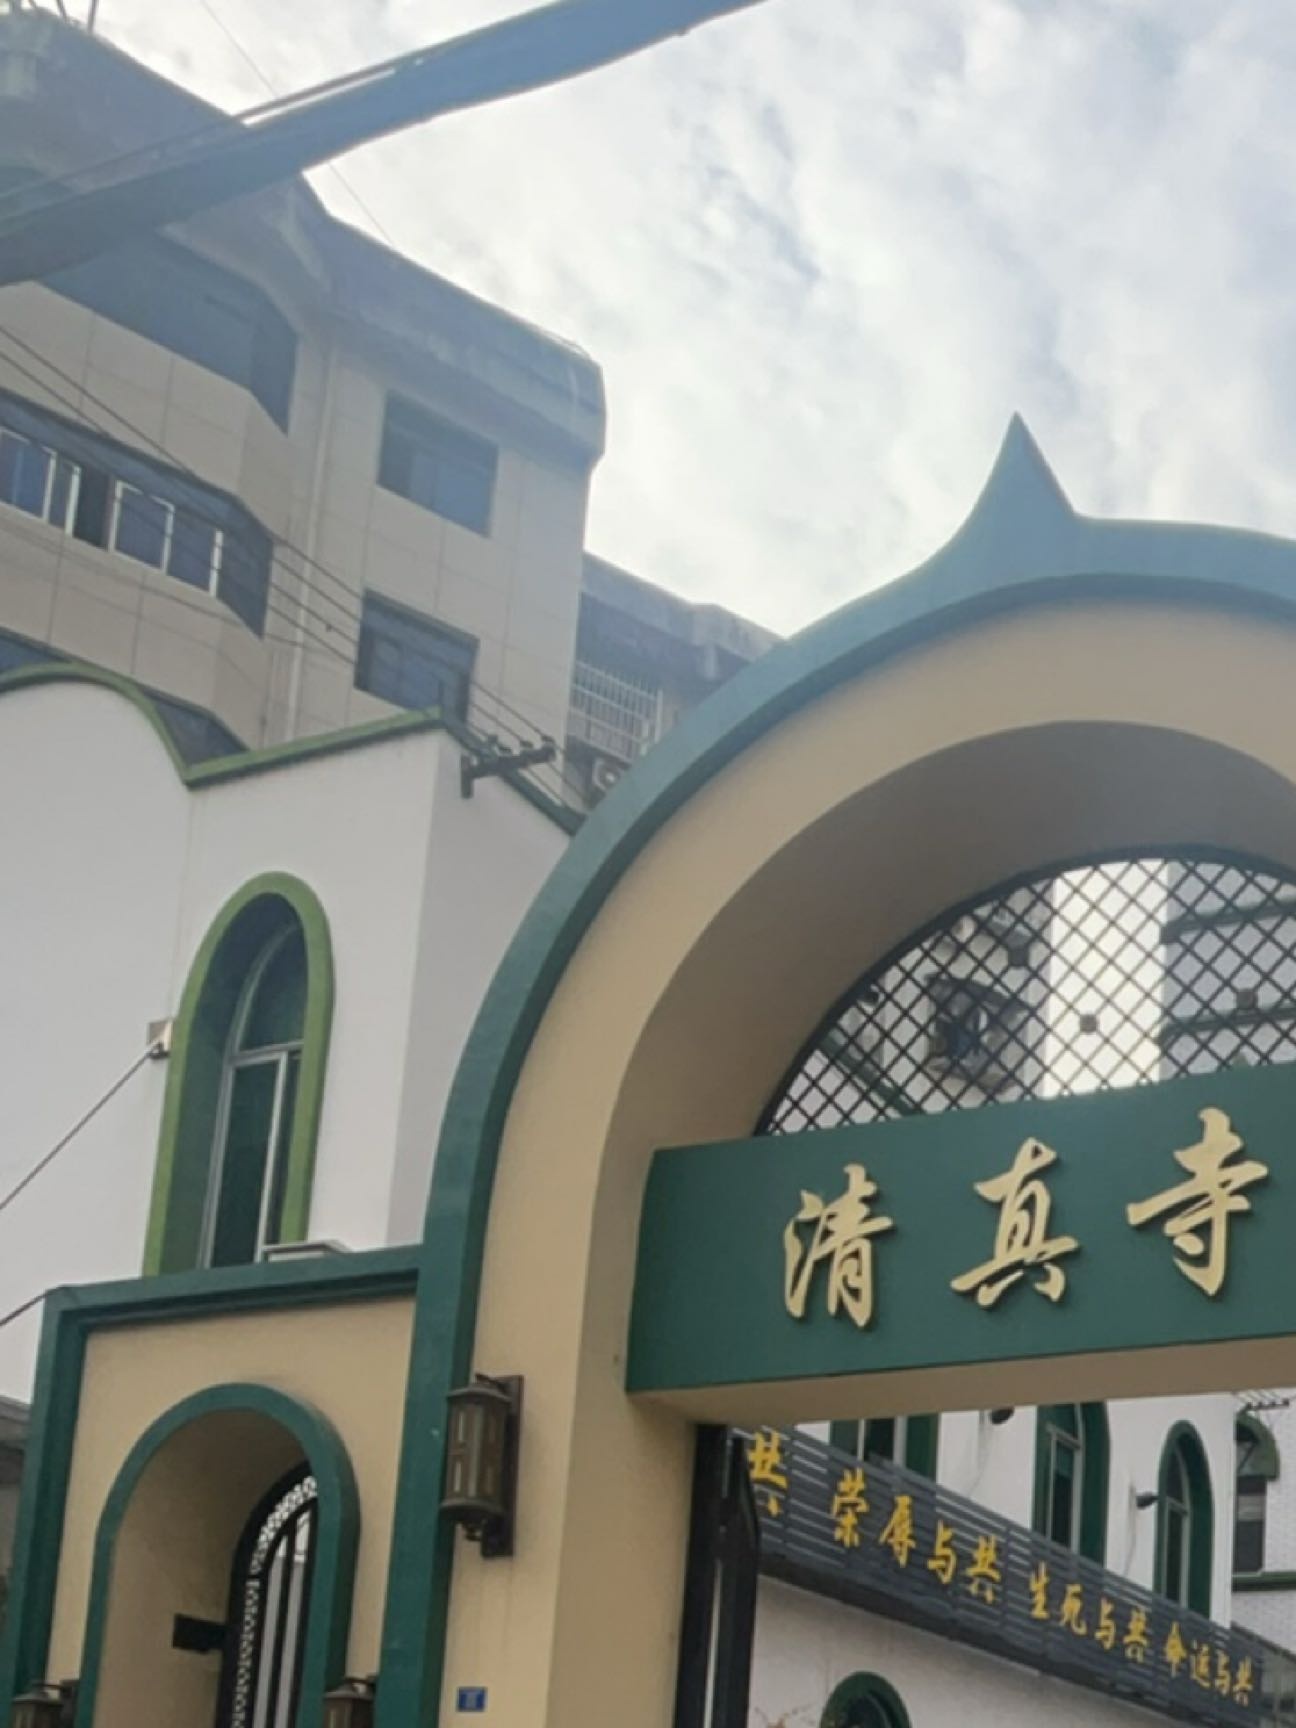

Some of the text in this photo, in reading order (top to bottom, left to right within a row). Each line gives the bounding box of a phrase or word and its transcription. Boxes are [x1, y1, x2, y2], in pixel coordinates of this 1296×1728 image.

[784, 1107, 1269, 1330] 清真寺
[831, 1466, 1002, 1605] 荣辱与共
[1029, 1559, 1149, 1664] 生死与共
[1164, 1620, 1254, 1707] 命运与共
